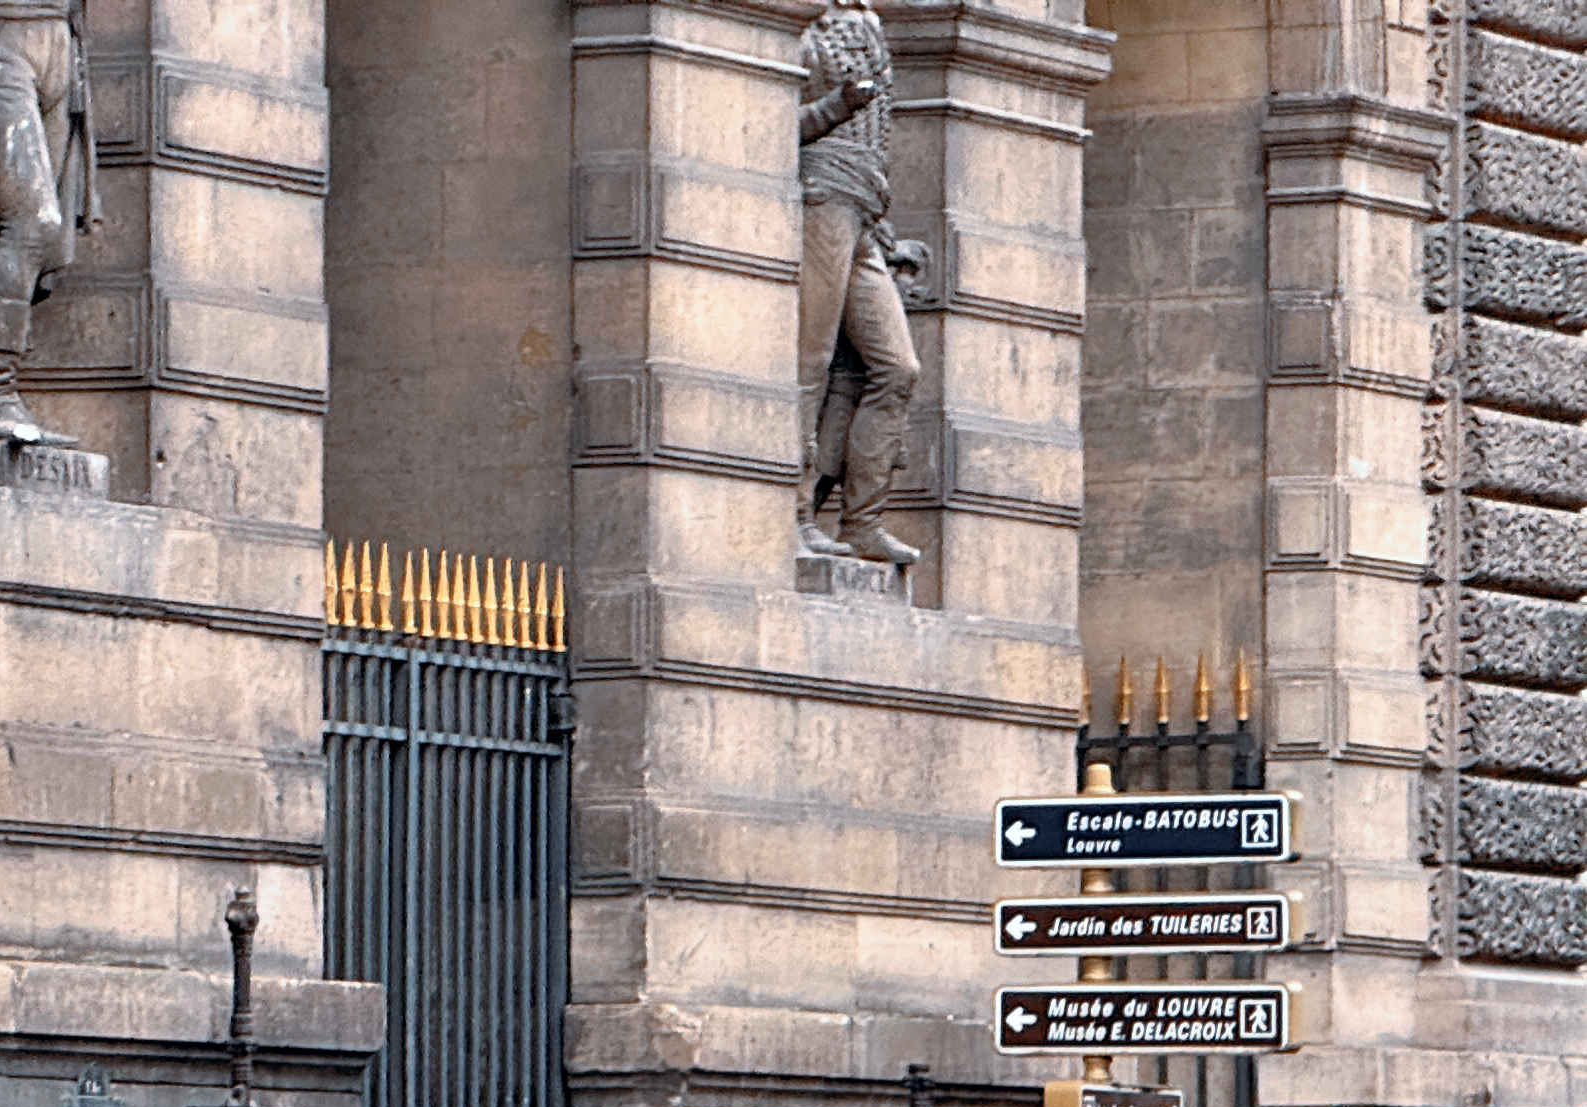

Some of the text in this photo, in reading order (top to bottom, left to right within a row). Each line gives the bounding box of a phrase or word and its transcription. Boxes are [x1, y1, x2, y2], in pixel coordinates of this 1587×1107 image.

[1066, 808, 1240, 831] Escale-BATOBUS
[1066, 837, 1122, 853] Louvre
[1048, 914, 1243, 937] Jardin des TUILERIES
[1047, 997, 1237, 1017] Musée du LOUVRE
[1046, 1021, 1237, 1041] Musée E. DELACROIX
